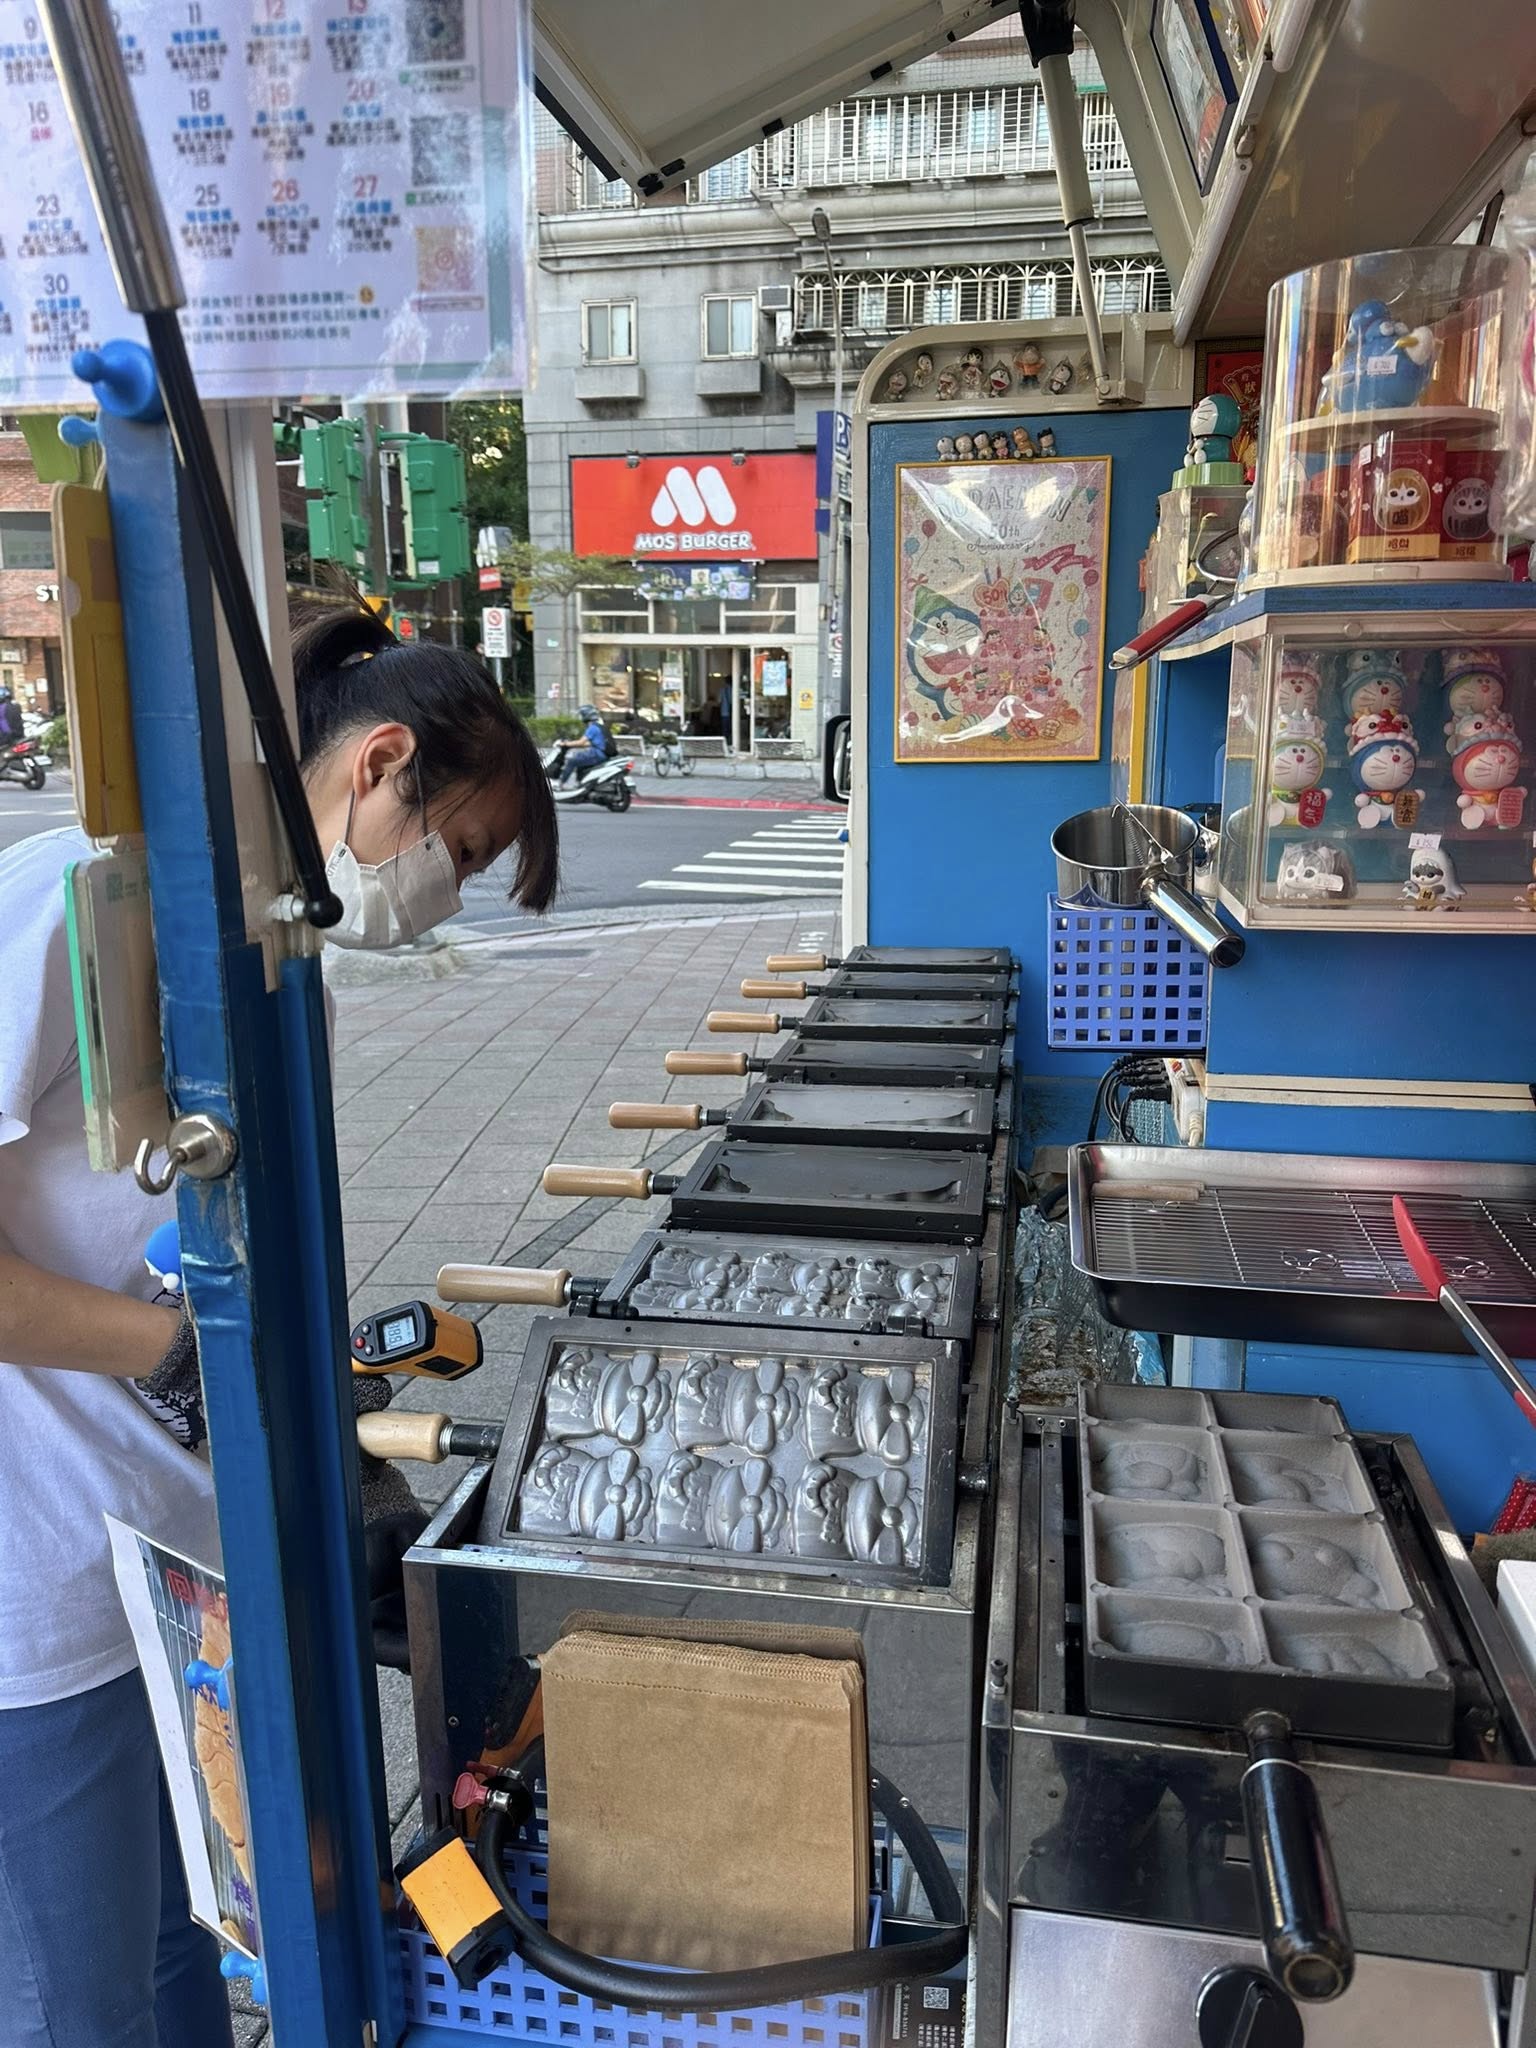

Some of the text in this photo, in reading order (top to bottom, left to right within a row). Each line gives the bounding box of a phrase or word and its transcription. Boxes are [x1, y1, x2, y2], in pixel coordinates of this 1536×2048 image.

[188, 3, 201, 24] 11
[190, 88, 210, 111] 18
[28, 100, 49, 122] 16
[194, 183, 220, 207] 25
[271, 178, 299, 203] 26
[353, 174, 378, 198] 27
[37, 194, 61, 216] 23
[43, 274, 69, 295] 30
[635, 531, 753, 550] MOS BURGER
